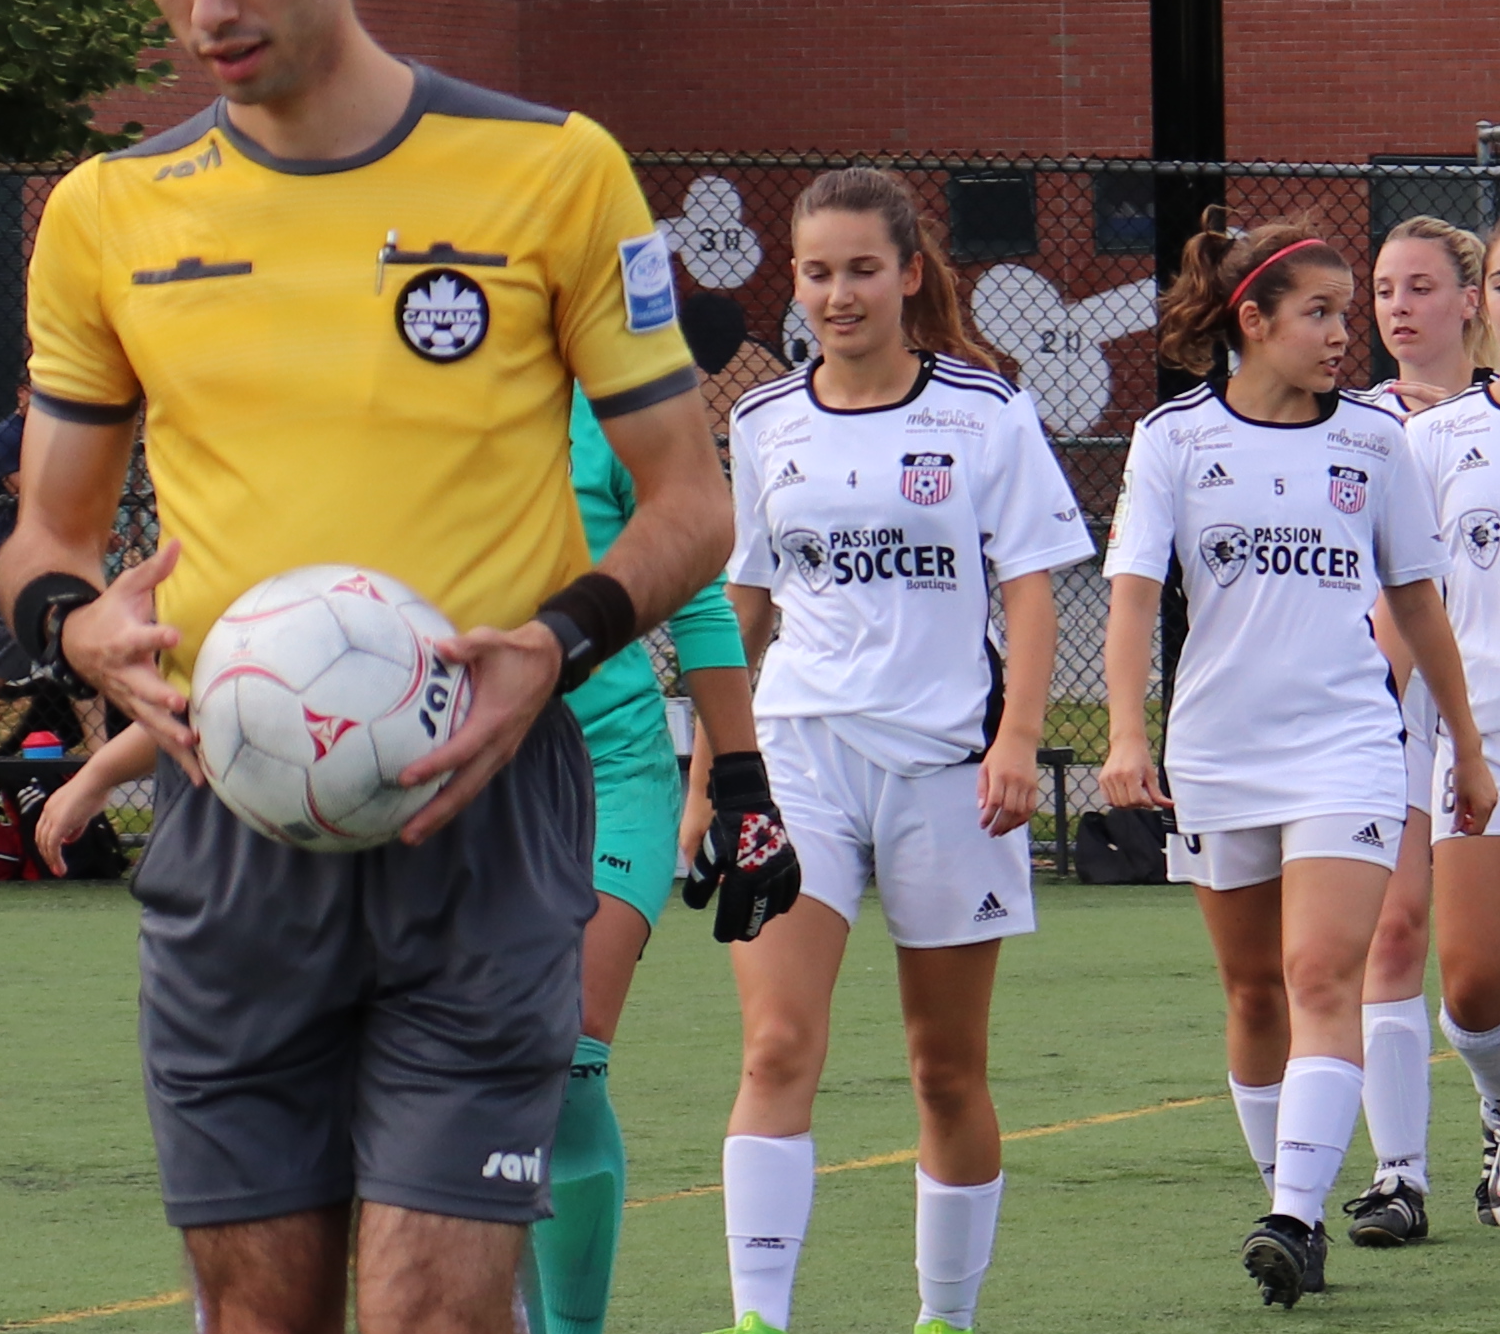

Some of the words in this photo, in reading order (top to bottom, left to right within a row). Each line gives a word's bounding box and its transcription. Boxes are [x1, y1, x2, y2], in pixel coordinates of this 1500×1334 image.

[152, 138, 221, 181] savi
[402, 309, 480, 326] CANADA
[913, 455, 943, 466] FSS
[1456, 459, 1490, 473] adidas
[772, 474, 806, 491] adidas
[846, 470, 858, 489] 4
[1198, 477, 1234, 489] adidas
[1338, 469, 1360, 481] FSS
[1274, 478, 1285, 495] 5
[829, 528, 904, 550] PASSION
[1254, 527, 1322, 544] PASSION
[832, 546, 957, 585] SOCCER
[1255, 545, 1360, 579] SOCCER
[905, 578, 957, 592] Boutique
[1318, 578, 1362, 591] Boutique
[1351, 834, 1384, 849] adidas
[973, 908, 1008, 922] adidas
[482, 1147, 540, 1184] savi
